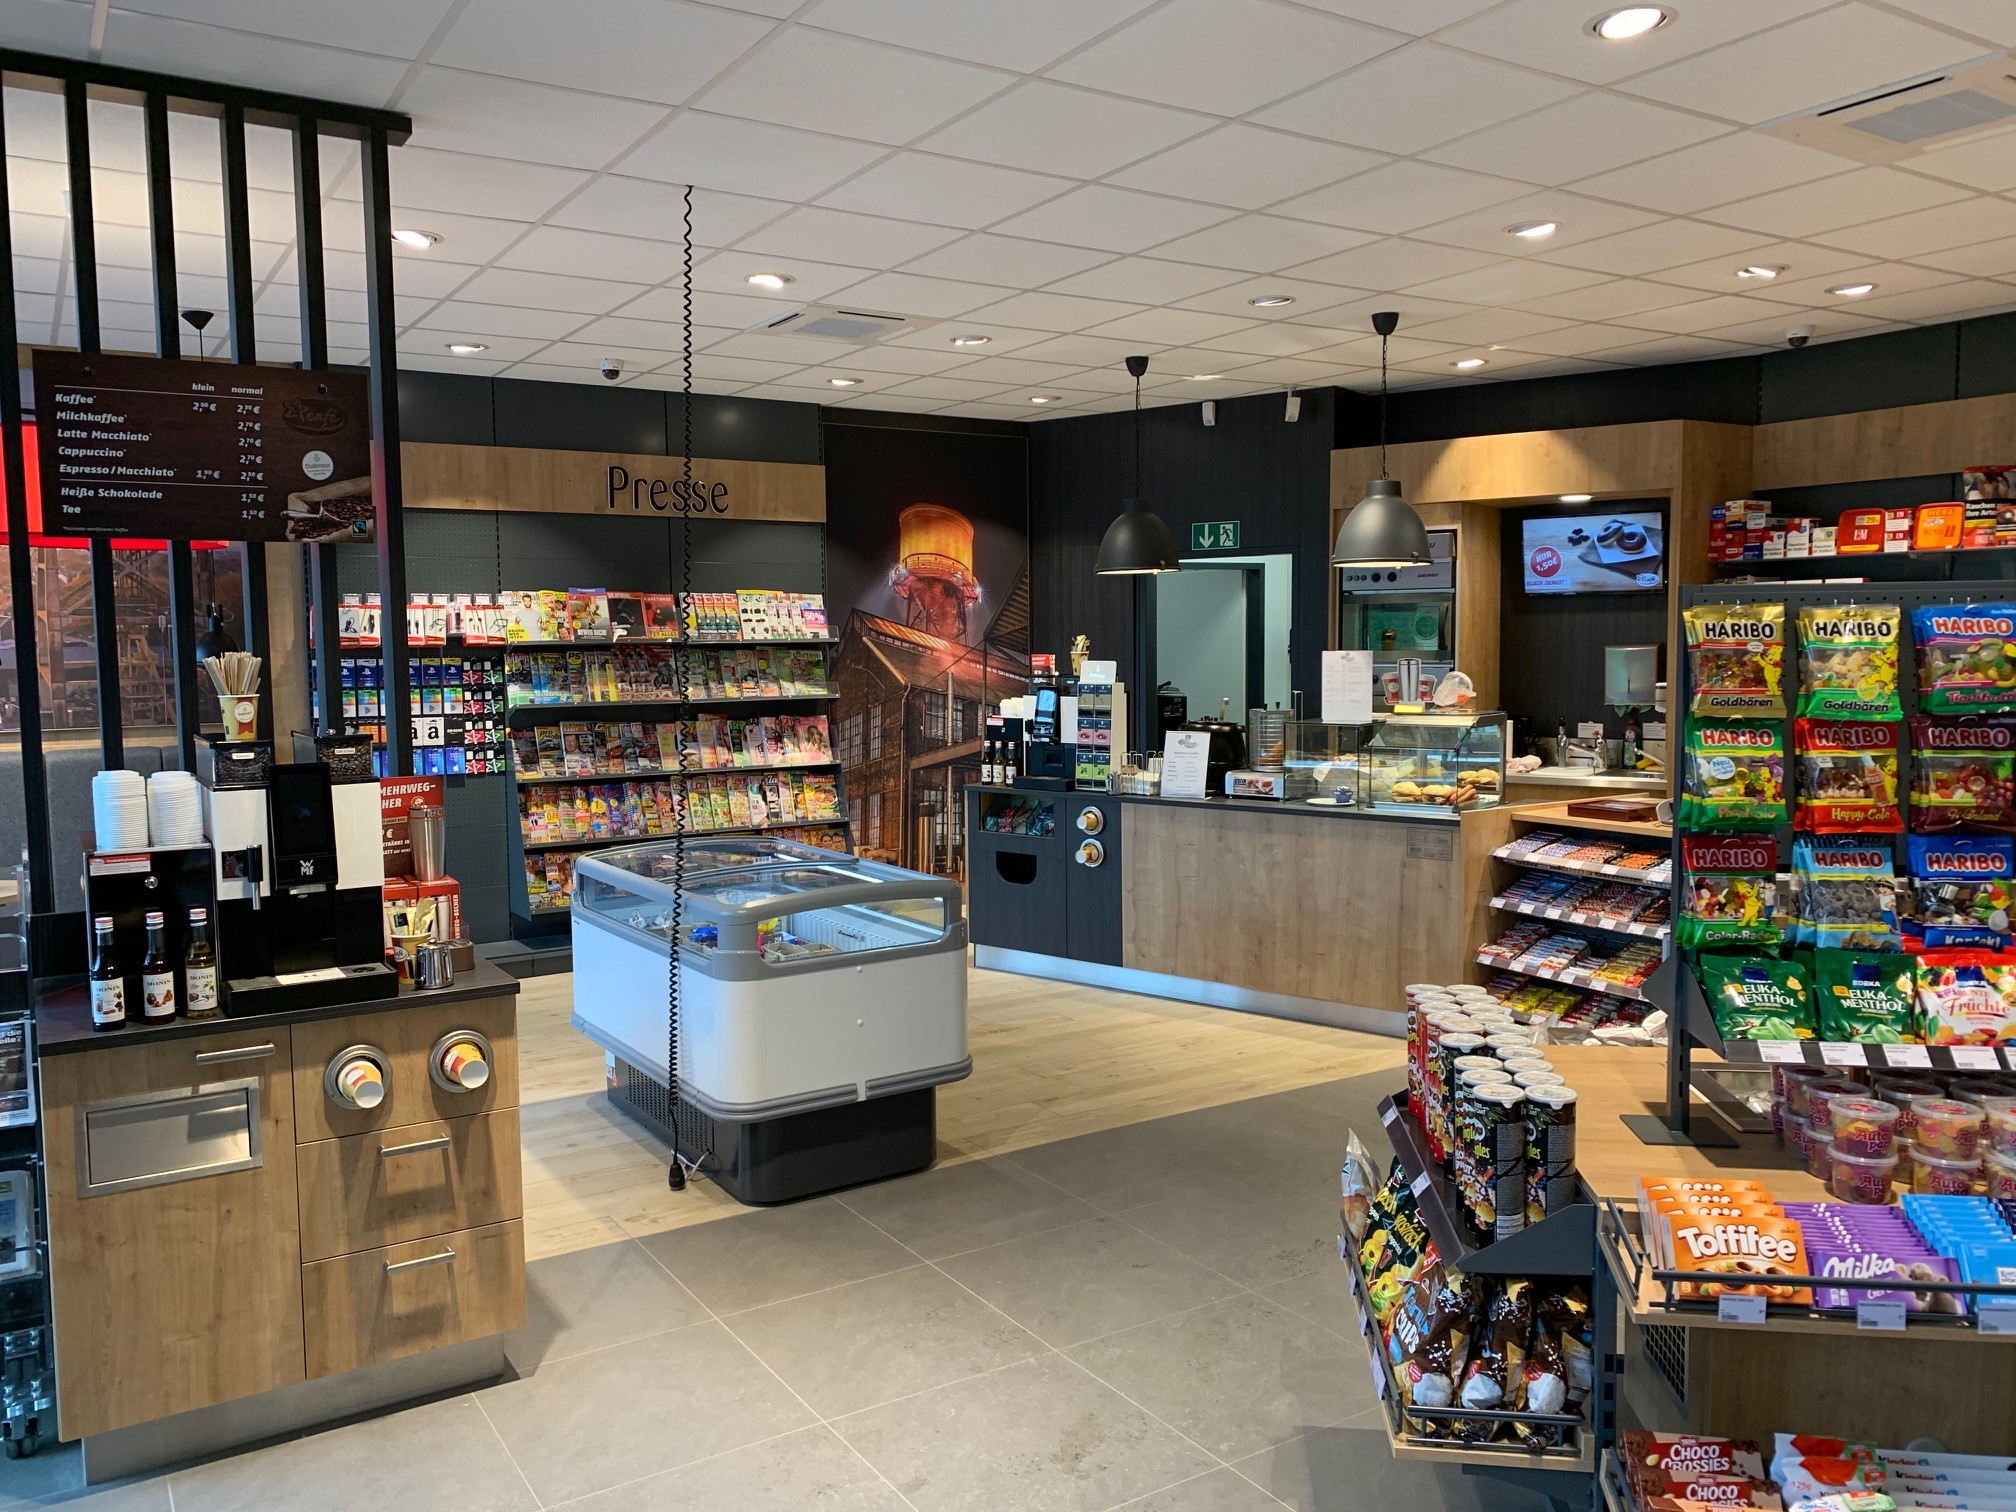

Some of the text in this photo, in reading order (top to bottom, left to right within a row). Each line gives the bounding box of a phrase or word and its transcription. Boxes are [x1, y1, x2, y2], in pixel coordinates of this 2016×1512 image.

[192, 383, 263, 394] klein normal
[57, 428, 88, 438] Latte
[61, 487, 95, 498] Heiße
[98, 488, 164, 499] Schokolade
[607, 465, 730, 514] Presse
[62, 504, 82, 514] Tee
[1965, 502, 1996, 510] Rauchen
[1536, 551, 1552, 563] NUR
[1704, 621, 1776, 639] HARIBO
[1814, 620, 1892, 638] HARIBO
[1932, 617, 2014, 636] HARIBO
[568, 652, 581, 660] PS
[1710, 696, 1773, 708] Goldbären
[1824, 700, 1890, 712] Goldbären
[1701, 728, 1775, 747] HARIBO
[1816, 727, 1891, 746] HARIBO
[1928, 728, 2010, 747] HARIBO
[1693, 849, 1768, 867] HARIBO
[1812, 850, 1884, 868] HARIBO
[1926, 852, 2007, 872] HARIBO
[300, 859, 314, 876] WMF
[96, 984, 120, 992] MONIN
[147, 979, 171, 987] MONIN
[1743, 985, 1785, 995] EUKA-
[1850, 990, 1892, 1000] EUKA-
[1840, 998, 1906, 1012] MENTHOL
[1942, 997, 2011, 1016] Früchte
[1677, 1224, 1797, 1262] Toffifee
[1822, 1253, 1896, 1278] Milka
[1670, 1445, 1720, 1460] CHOCO
[1686, 1484, 1738, 1500] CHOCO
